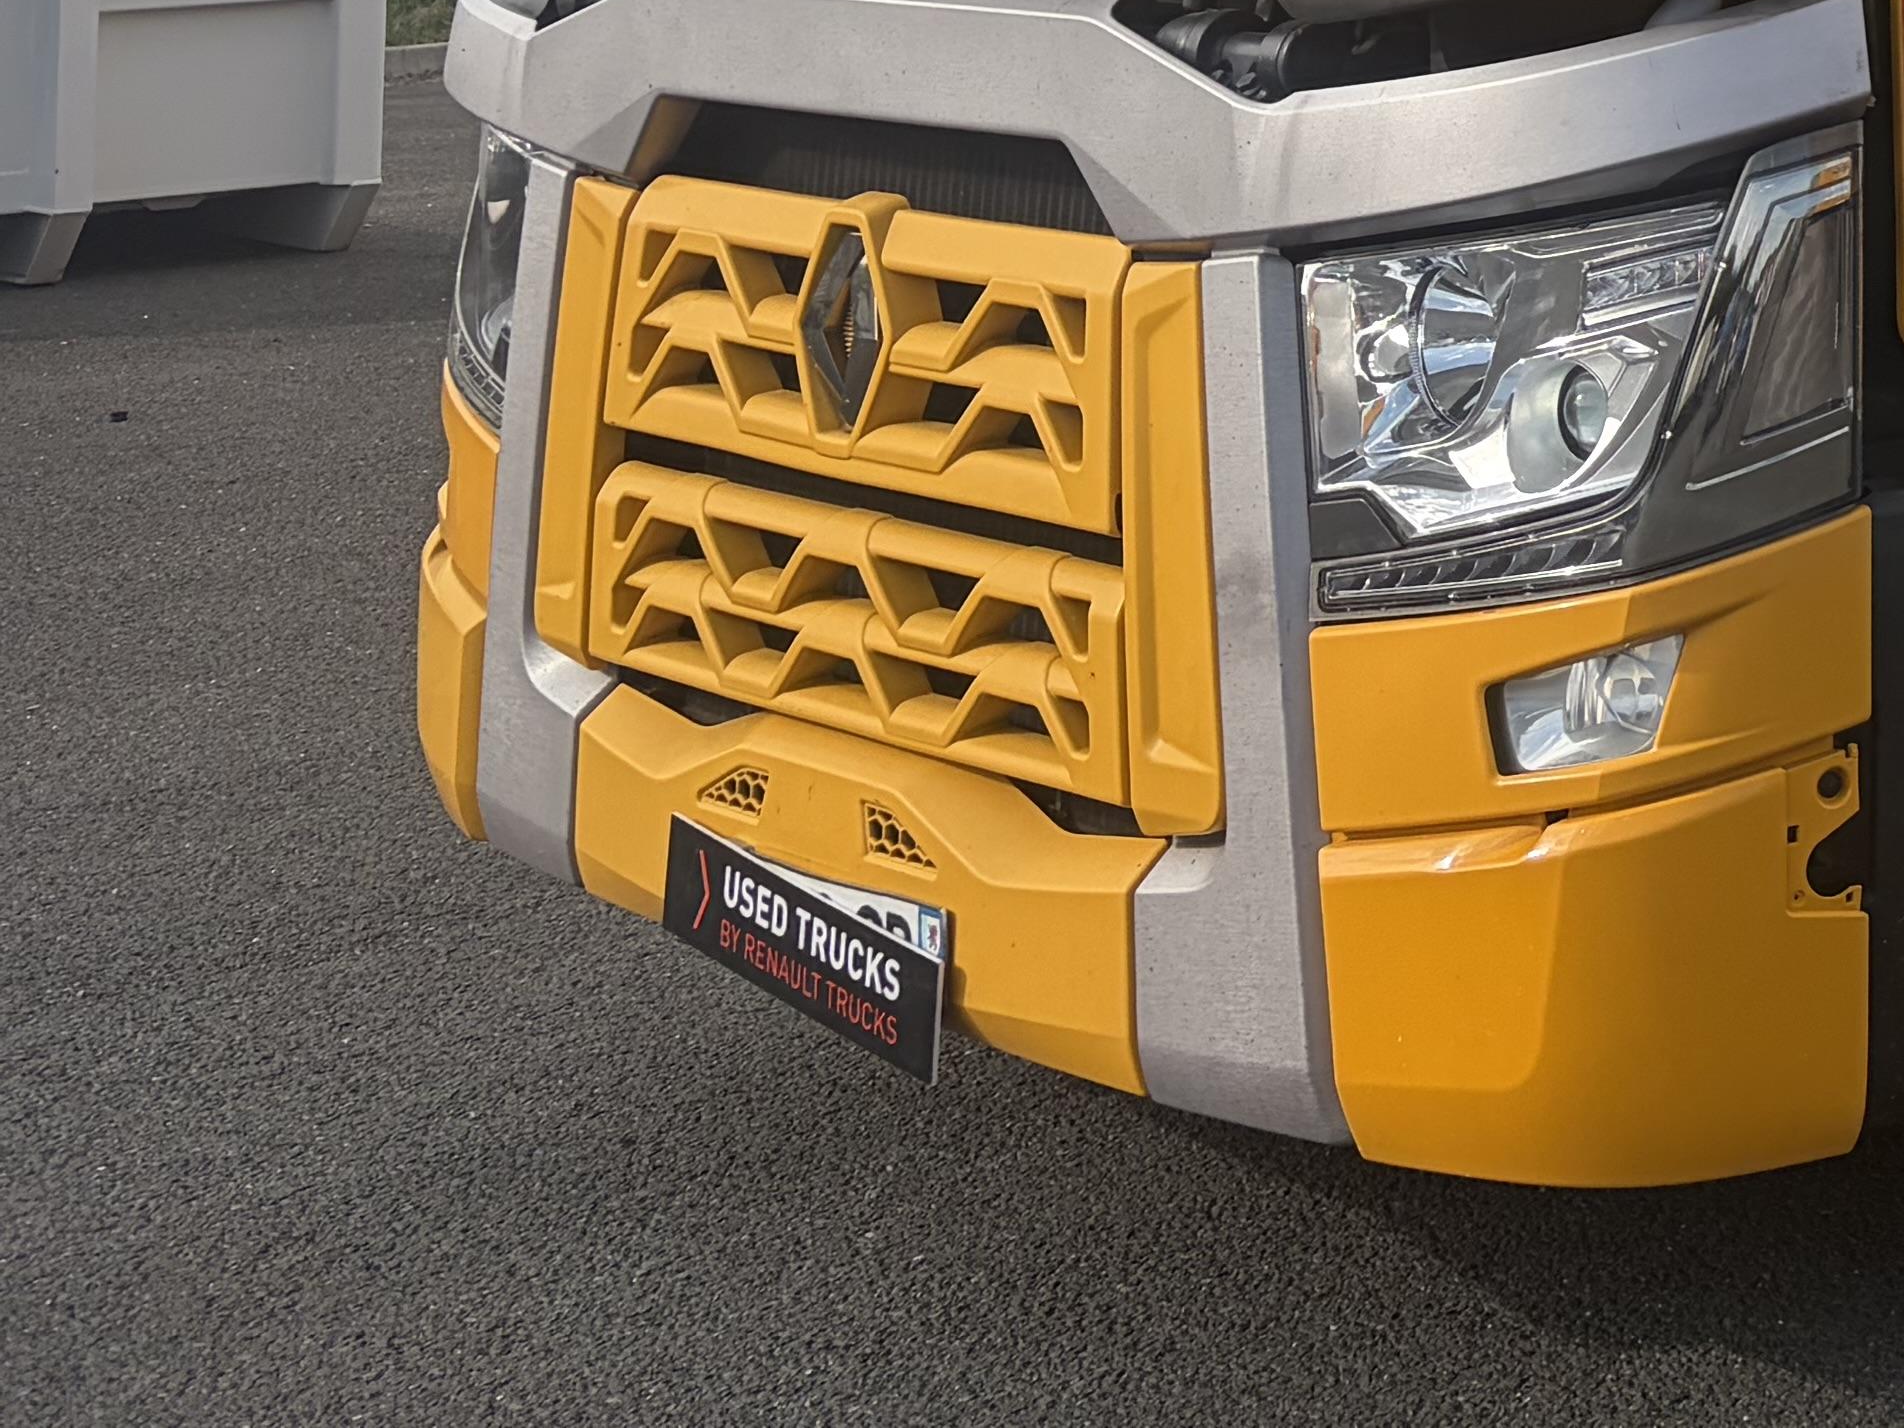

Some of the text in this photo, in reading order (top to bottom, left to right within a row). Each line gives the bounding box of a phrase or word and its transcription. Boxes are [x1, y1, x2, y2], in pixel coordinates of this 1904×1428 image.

[719, 919, 898, 1045] BY RENAULT TRUCKS
[722, 864, 789, 937] USED
[795, 906, 901, 1001] TRUCKS
